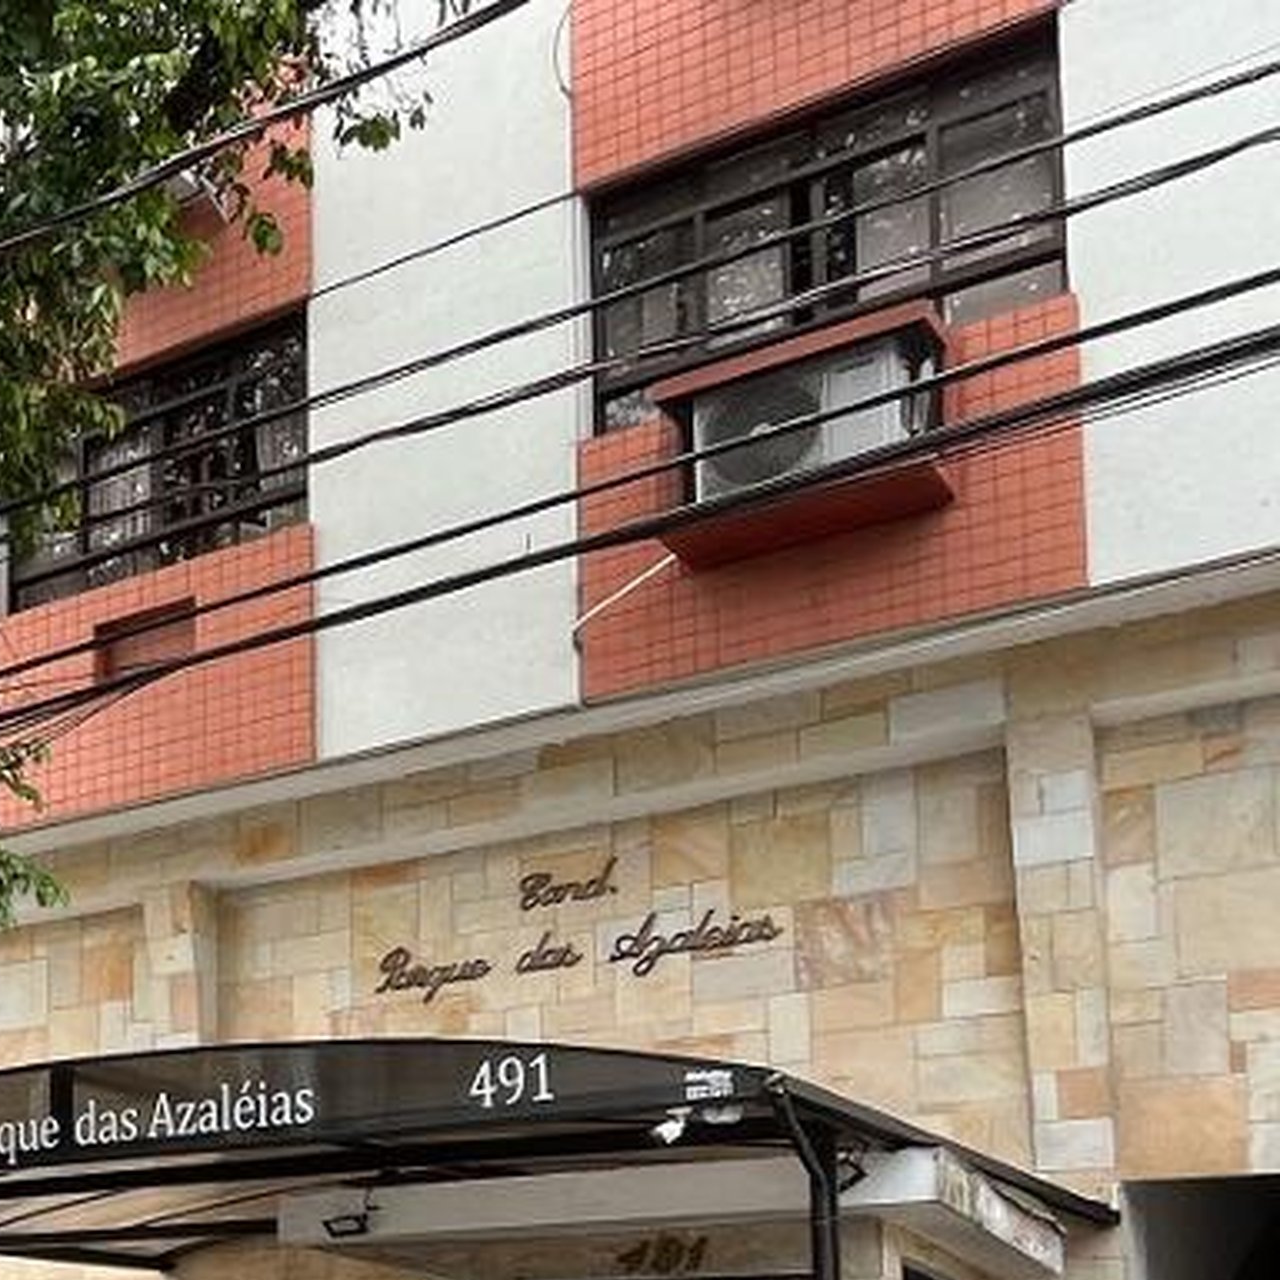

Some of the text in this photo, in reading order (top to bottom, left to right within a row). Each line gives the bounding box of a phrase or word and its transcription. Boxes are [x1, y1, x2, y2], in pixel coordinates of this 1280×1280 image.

[515, 930, 584, 975] das
[469, 1053, 555, 1108] 491
[74, 1100, 138, 1146] das
[148, 1079, 315, 1140] Azaléias
